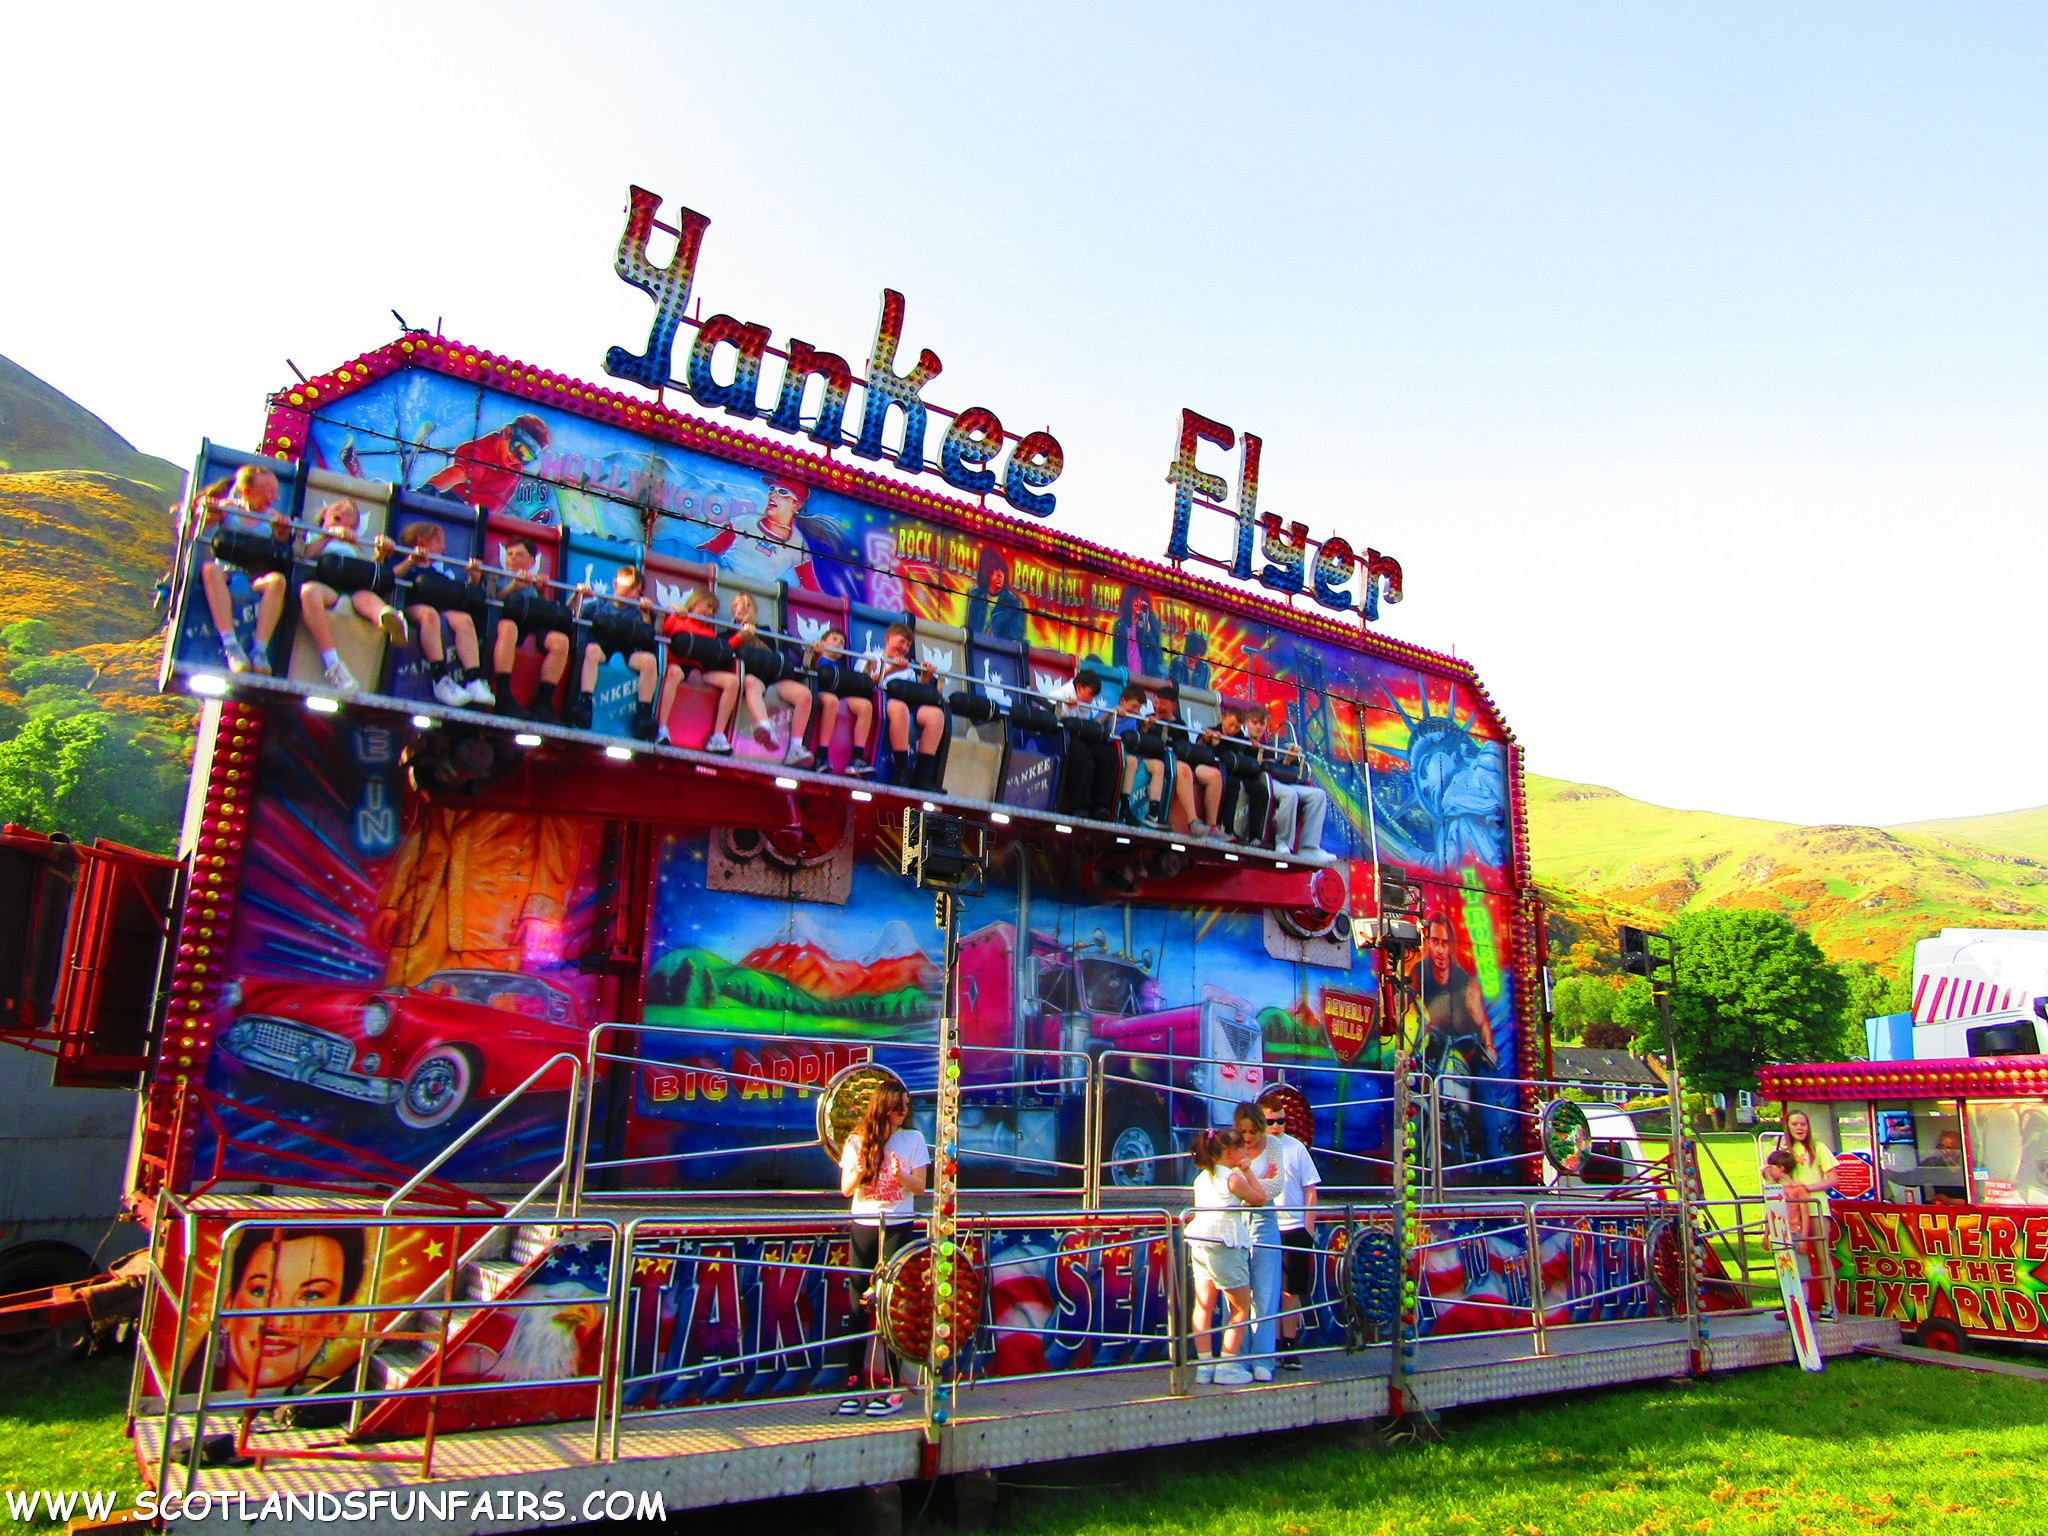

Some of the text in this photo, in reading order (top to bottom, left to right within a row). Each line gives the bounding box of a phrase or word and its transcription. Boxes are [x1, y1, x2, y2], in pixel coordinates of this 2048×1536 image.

[602, 184, 1404, 621] Yankee Flyer
[519, 482, 548, 505] IT'S
[897, 528, 932, 562] ROCK
[1012, 560, 1044, 598] ROCK
[1325, 996, 1372, 1023] BEVERLY
[1331, 1017, 1364, 1041] HILLS
[654, 1067, 728, 1101] BIG
[1919, 1213, 2048, 1261] HERE
[1854, 1256, 2016, 1285] FOR THE
